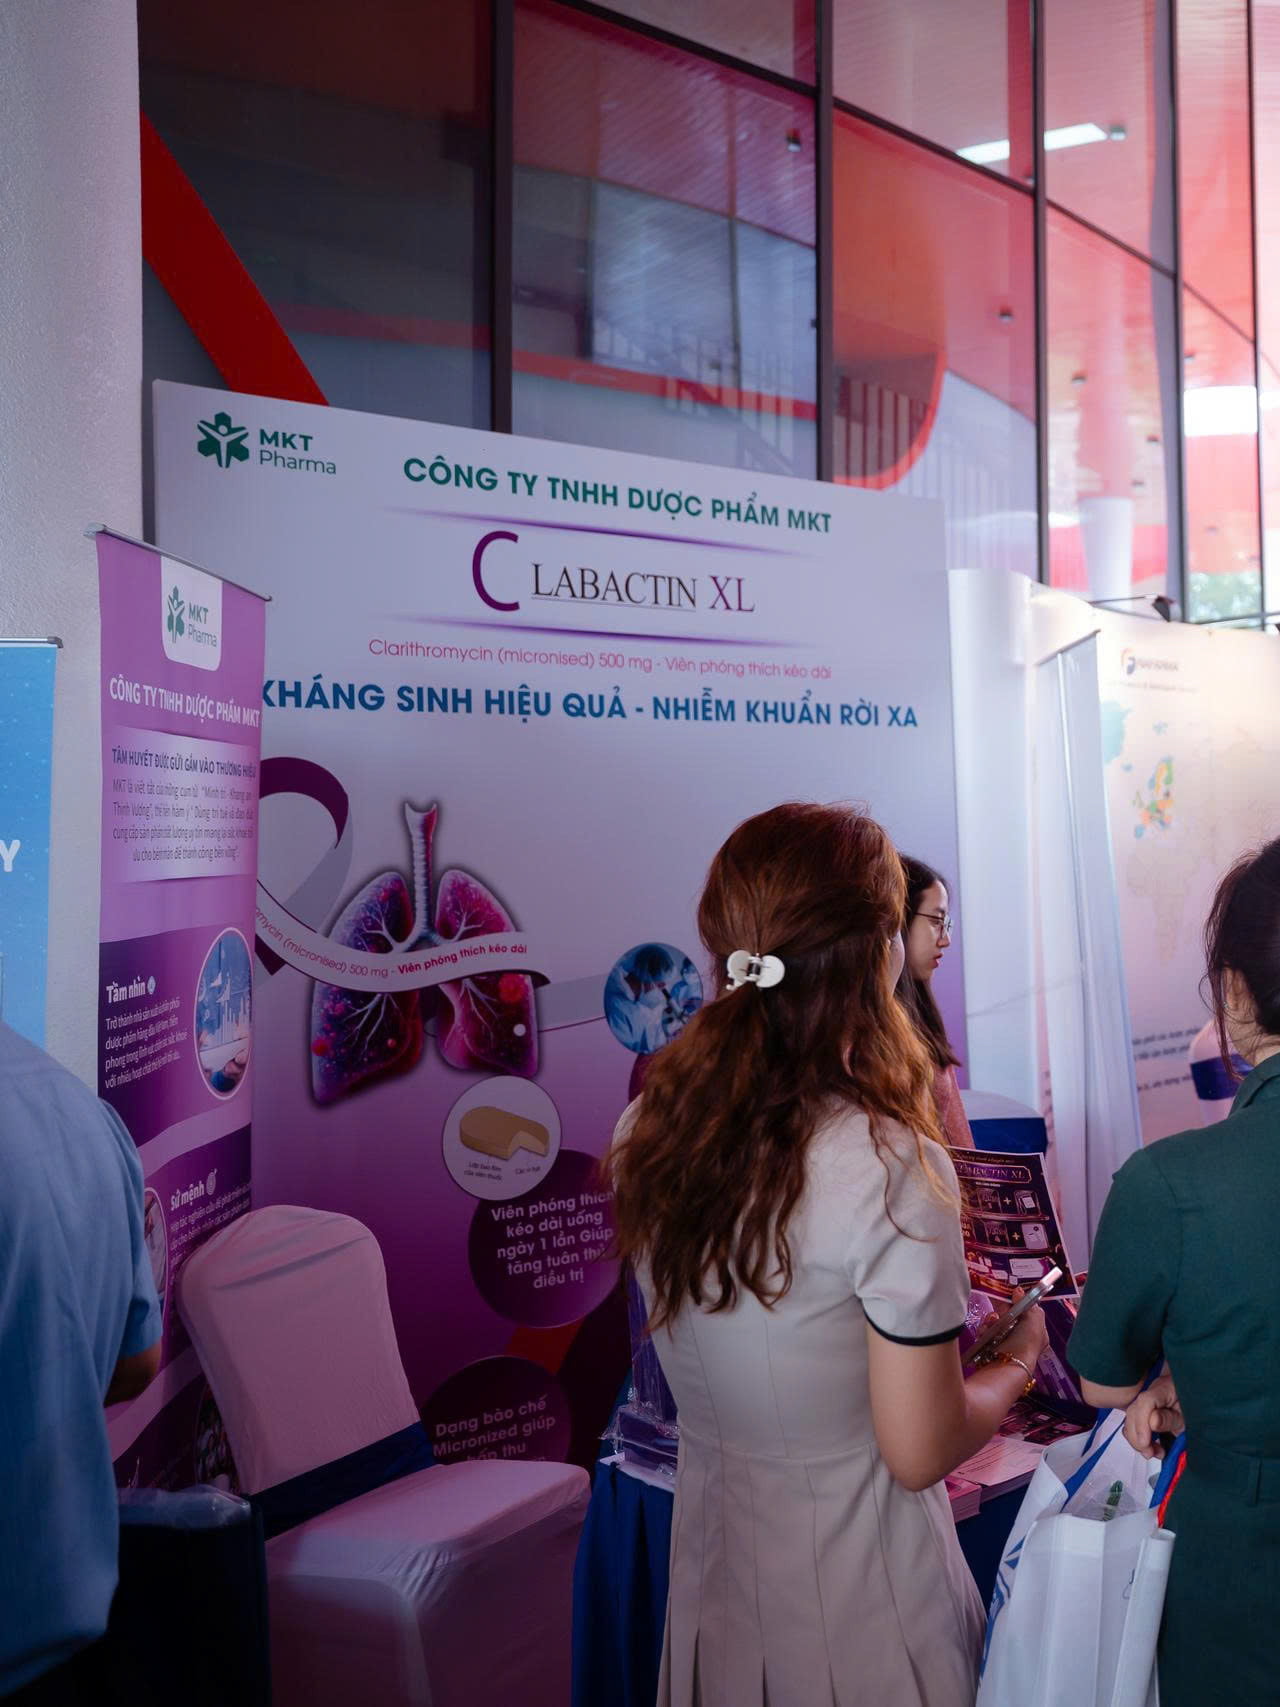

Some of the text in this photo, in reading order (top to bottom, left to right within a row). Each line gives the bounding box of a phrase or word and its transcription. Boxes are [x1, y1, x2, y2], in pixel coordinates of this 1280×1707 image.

[259, 428, 313, 451] MKT
[259, 449, 337, 475] Pharma
[403, 455, 832, 533] CÔNG TY TNHH DƯỢC PHẨM MKT
[709, 575, 756, 612] XL
[188, 602, 209, 625] MKT
[188, 623, 217, 648] Pharma
[368, 638, 493, 663] Clarithromycin
[498, 648, 595, 669] (micronised)
[598, 653, 625, 668] 500
[628, 657, 653, 673] mg
[700, 659, 745, 678] phóng
[748, 662, 781, 678] thích
[810, 665, 833, 679] dài
[109, 674, 141, 704] CÔNG
[143, 685, 157, 707] TY
[158, 688, 183, 713] TNHH
[185, 693, 215, 723] DƯỢC
[242, 707, 260, 728] MKT
[396, 685, 472, 714] SINH
[484, 684, 552, 723] HIỆU
[562, 686, 627, 719] QUẢ
[652, 688, 736, 722] NHIỄM
[745, 690, 831, 725] KHUẨN
[840, 698, 879, 726] RỜI
[888, 706, 918, 727] XA
[199, 756, 215, 774] VÀO
[349, 965, 369, 976] 500
[424, 953, 458, 971] phóng
[106, 976, 146, 1003] Tầm nhìn
[180, 1180, 205, 1206] mệnh
[491, 1205, 524, 1221] Viên
[528, 1197, 576, 1218] phóng
[506, 1209, 604, 1238] kéo dài uống
[497, 1226, 615, 1259] ngày 1 lần Giúp
[507, 1260, 543, 1276] tăng
[546, 1251, 580, 1268] tuân
[532, 1267, 585, 1289] điều trị
[435, 1393, 548, 1438] Dạng bào chế
[433, 1415, 557, 1457] Micronized giúp
[502, 1442, 527, 1458] thu
